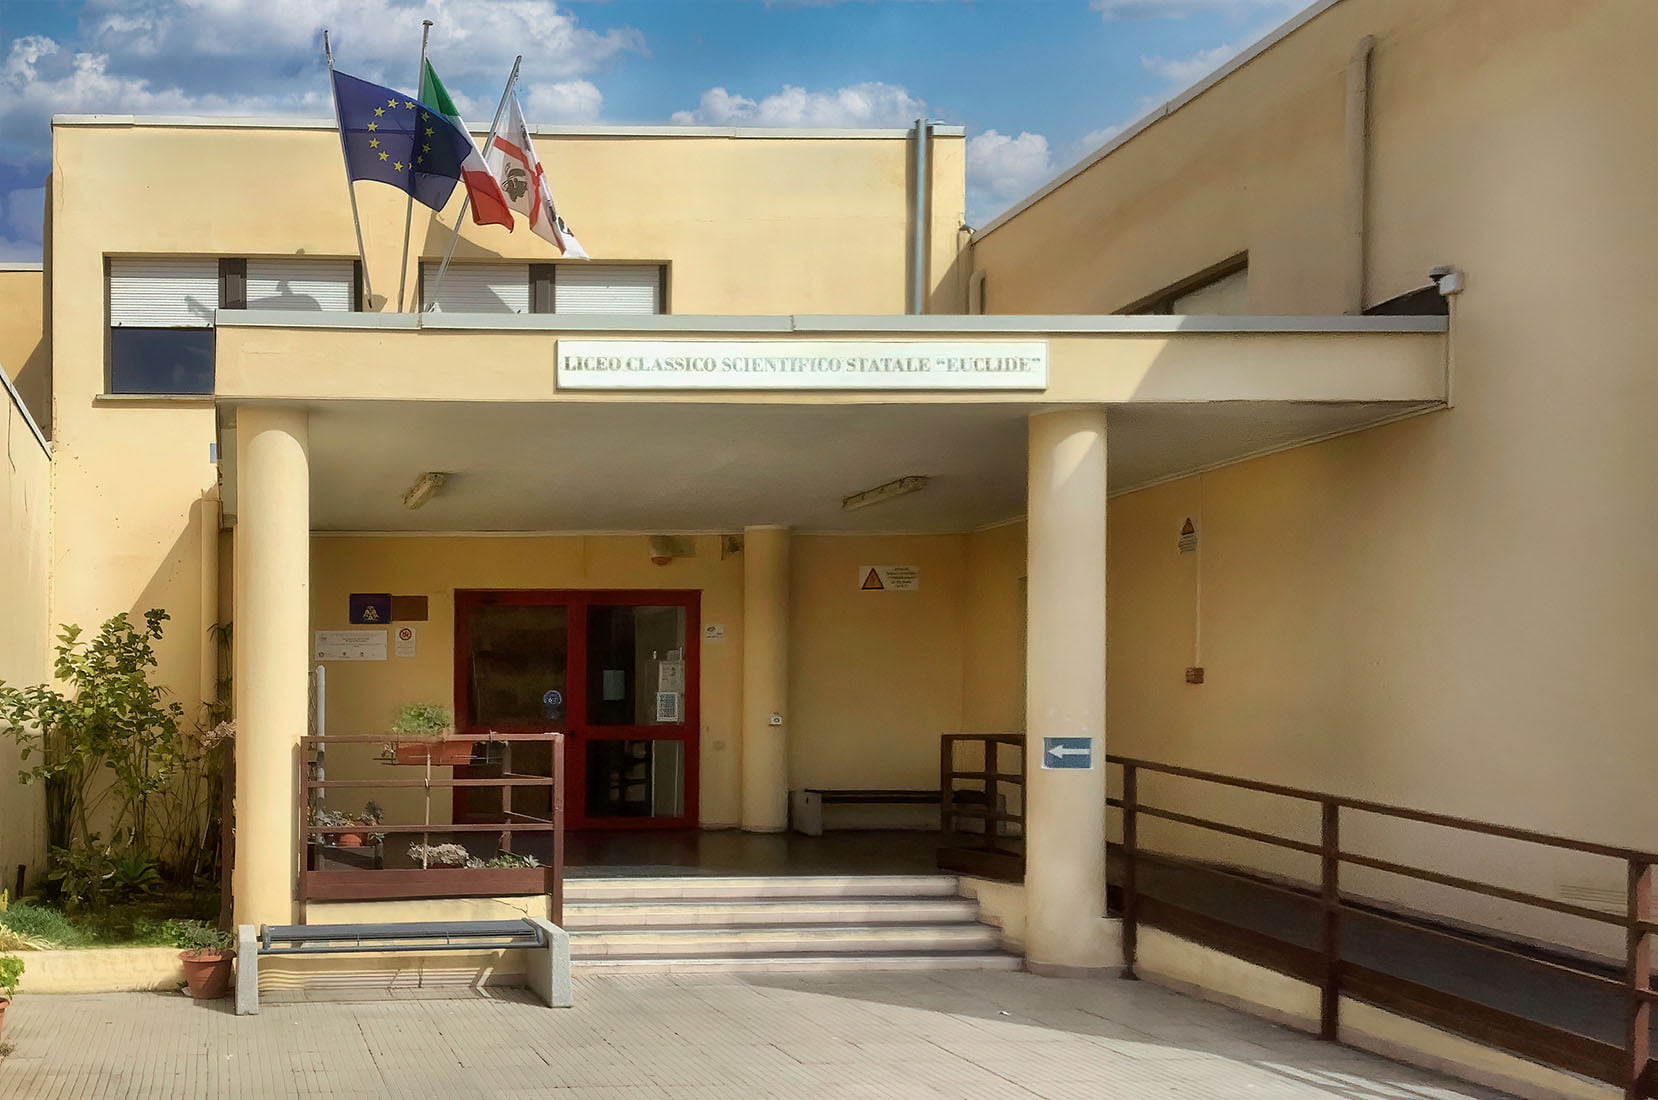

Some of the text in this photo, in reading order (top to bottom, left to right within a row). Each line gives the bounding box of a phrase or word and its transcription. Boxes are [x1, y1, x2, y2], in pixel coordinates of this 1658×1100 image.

[564, 356, 622, 372] LICEO
[626, 356, 718, 372] CLASSICO
[720, 356, 843, 372] SCIENTIFICO
[846, 357, 931, 372] STATALE
